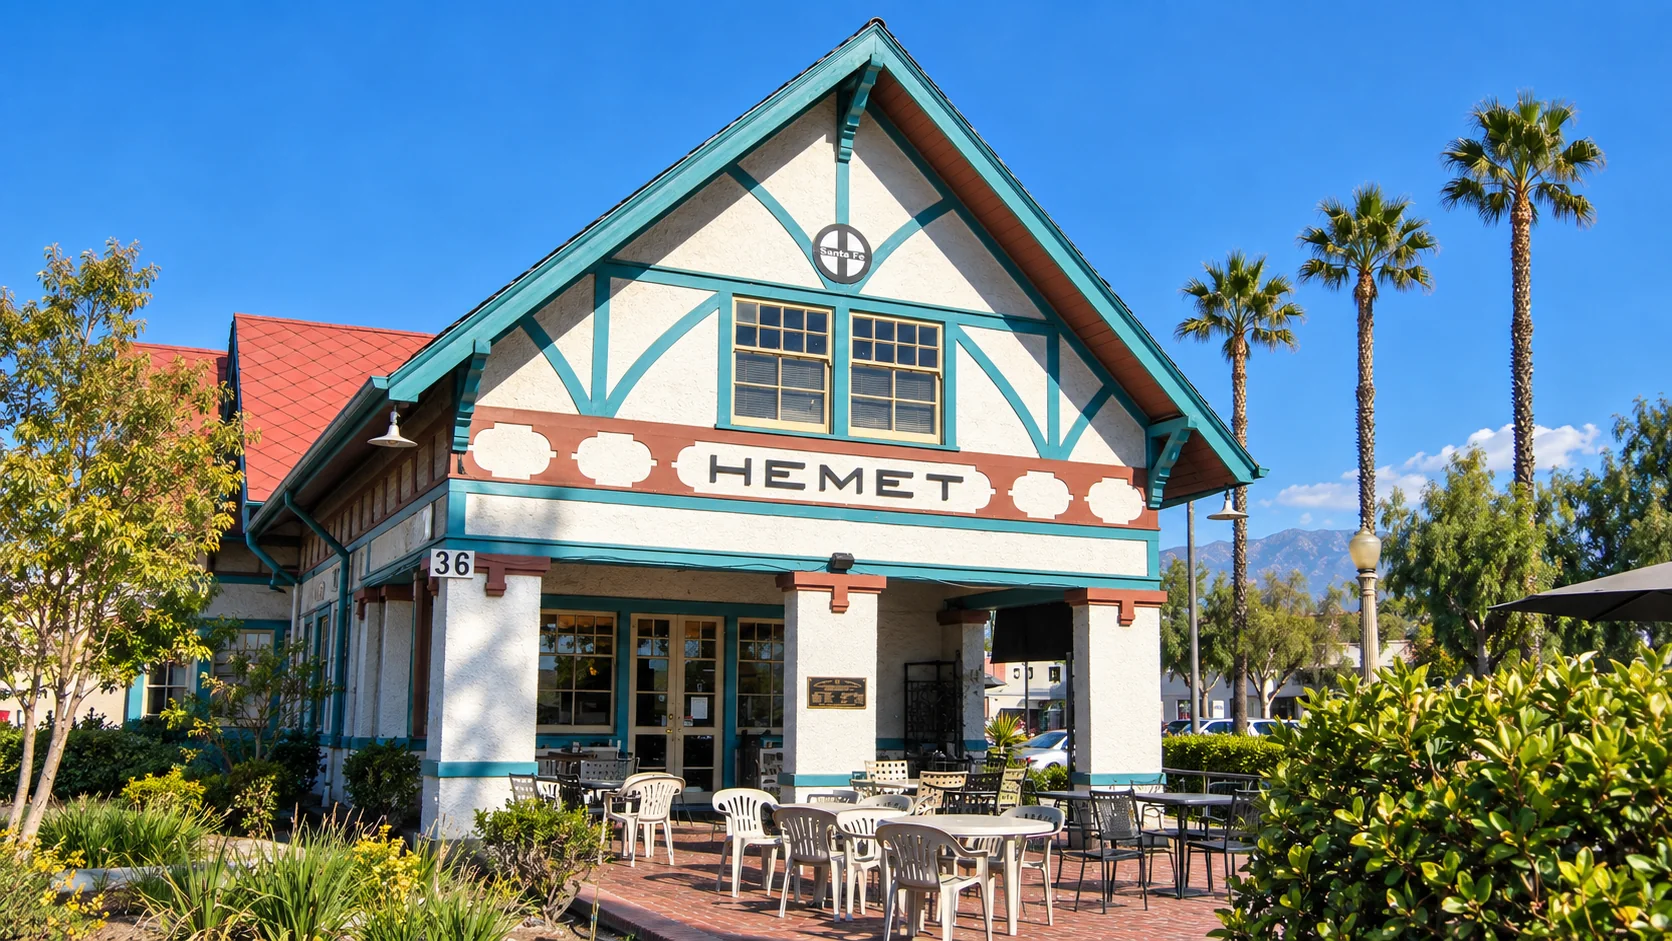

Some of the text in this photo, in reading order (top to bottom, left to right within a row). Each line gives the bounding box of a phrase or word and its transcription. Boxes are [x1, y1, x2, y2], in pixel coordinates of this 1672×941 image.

[820, 247, 865, 260] Santa Fe
[709, 454, 964, 501] HEMET
[435, 551, 469, 575] 36
